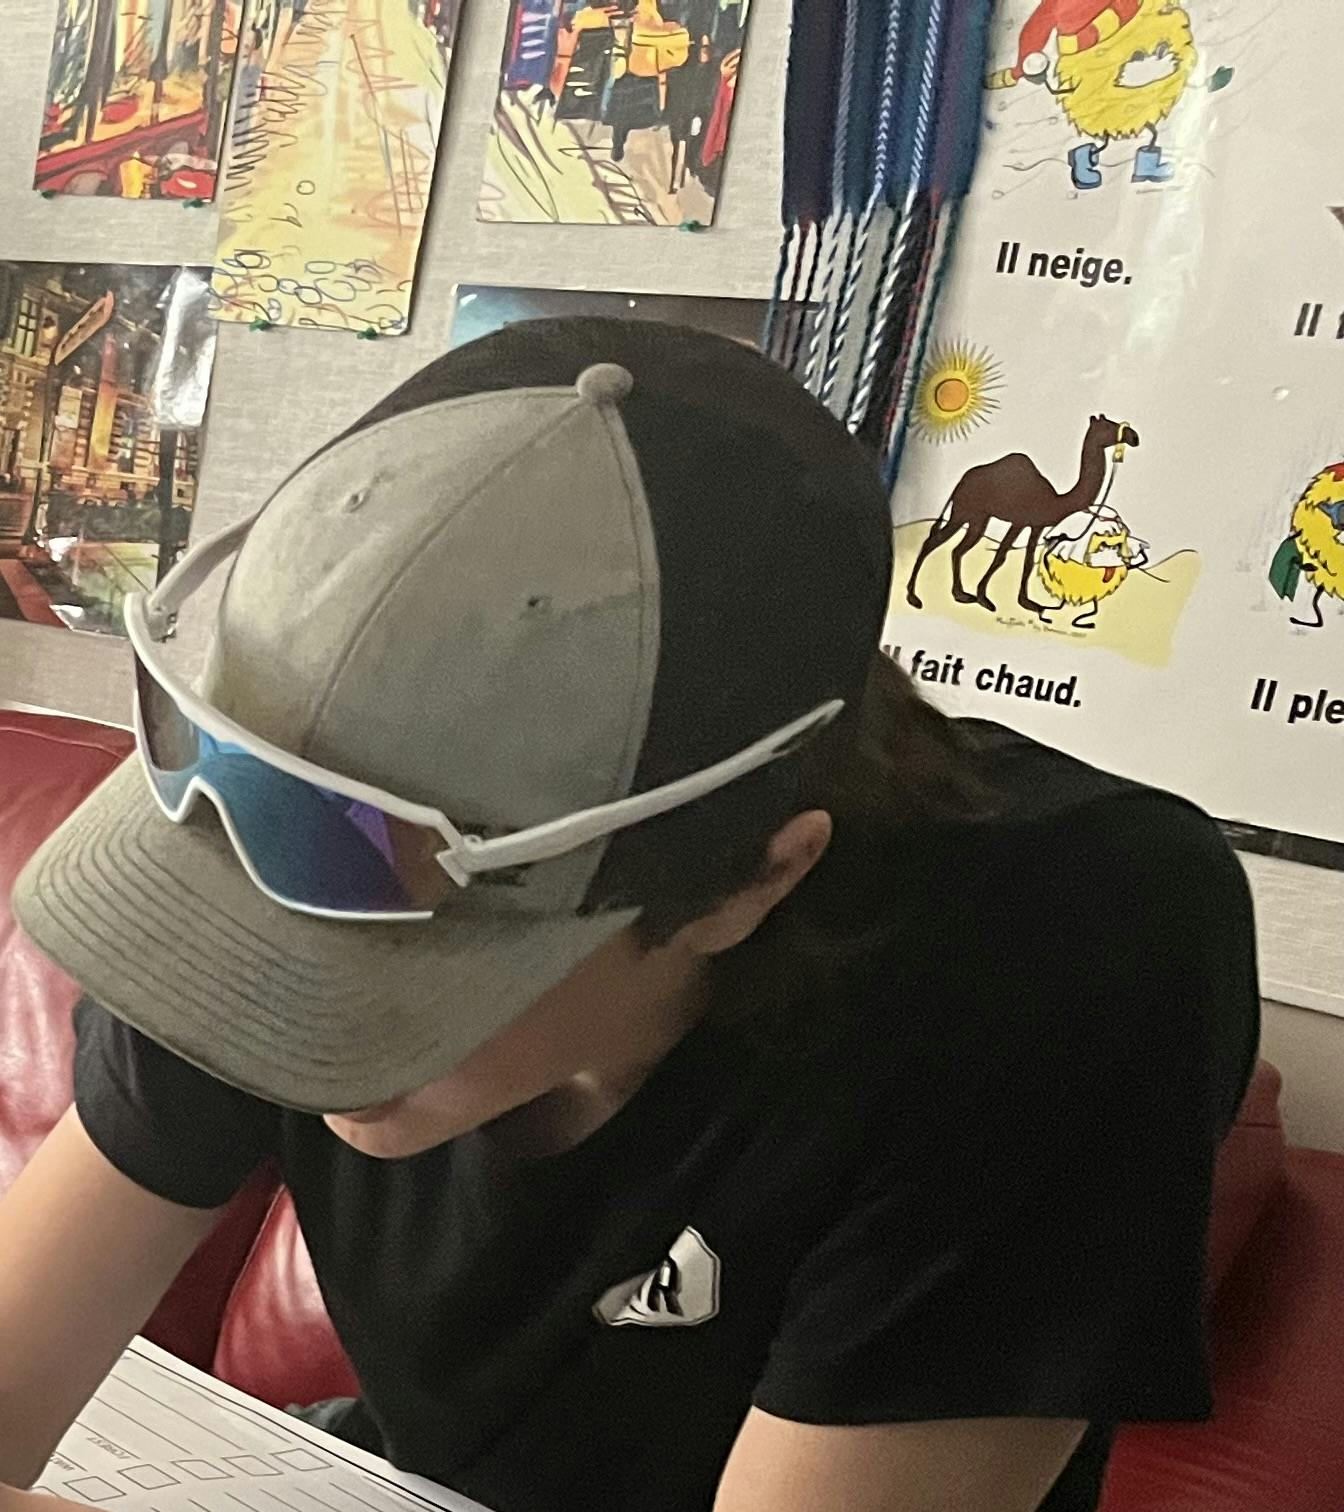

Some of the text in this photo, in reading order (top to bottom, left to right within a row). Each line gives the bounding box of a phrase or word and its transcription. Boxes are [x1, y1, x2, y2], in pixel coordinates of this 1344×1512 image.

[1027, 247, 1133, 288] neige.
[911, 649, 964, 686] fait
[975, 663, 1082, 708] chaud.
